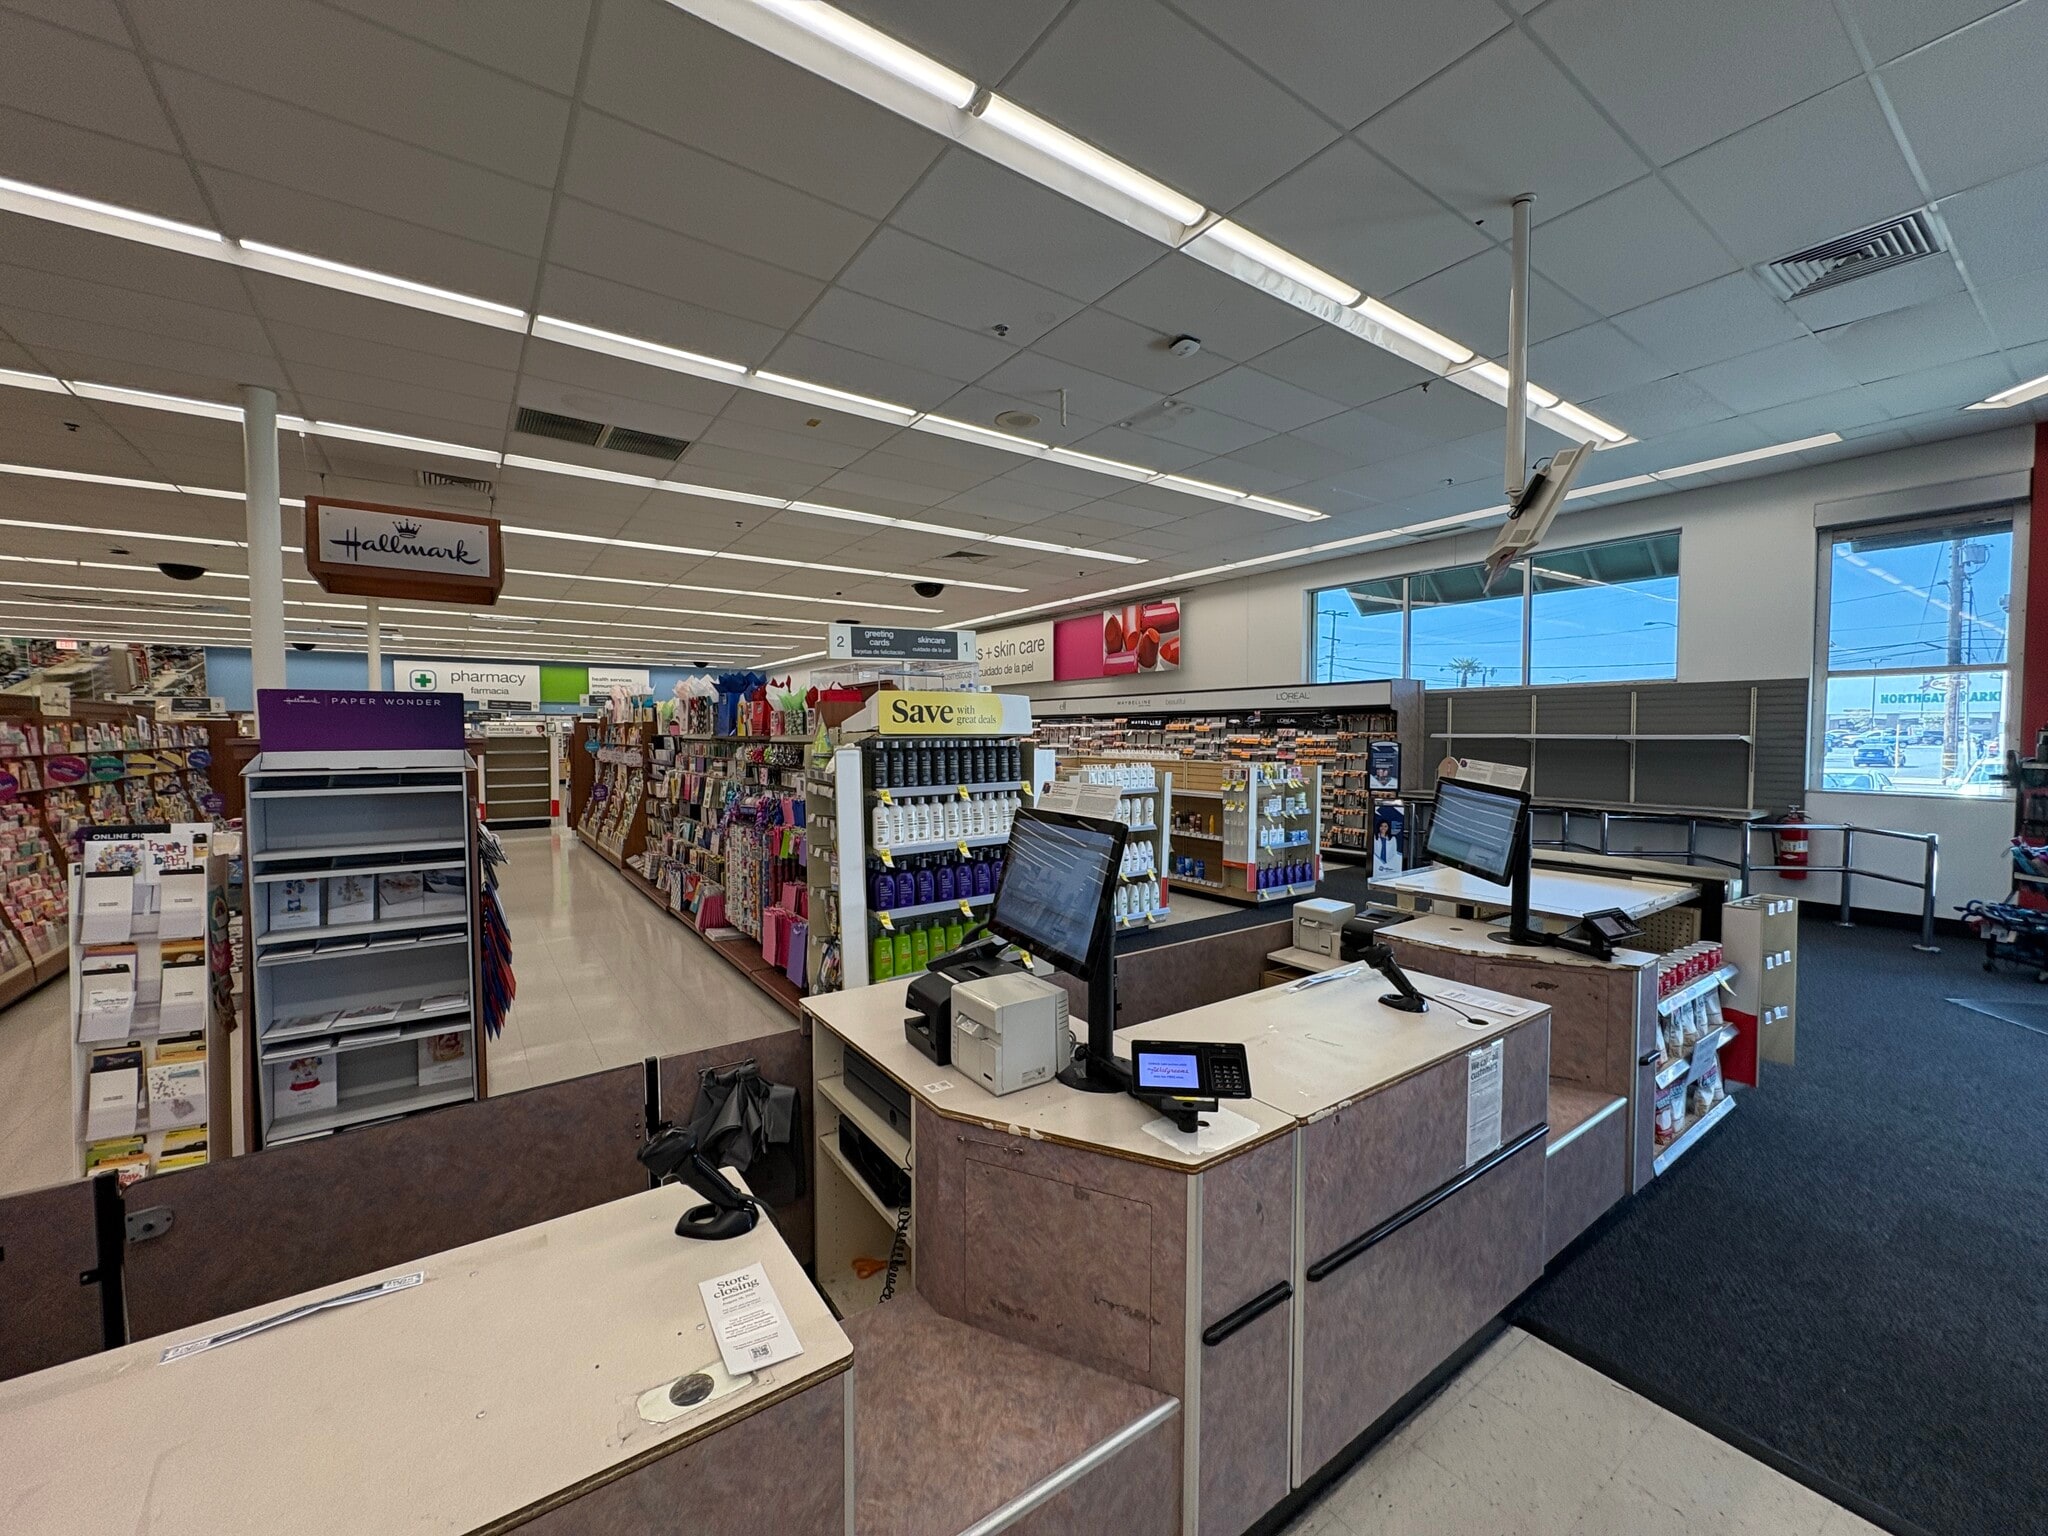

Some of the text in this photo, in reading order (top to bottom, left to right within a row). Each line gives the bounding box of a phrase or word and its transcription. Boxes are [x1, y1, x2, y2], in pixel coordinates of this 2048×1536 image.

[329, 526, 481, 565] Hallmark
[864, 630, 895, 640] greeting
[917, 636, 946, 645] skincare
[836, 635, 845, 648] 2
[868, 638, 891, 647] cards
[963, 641, 969, 652] 1
[994, 639, 1016, 659] skin
[1018, 637, 1046, 655] care
[977, 664, 1003, 678] cuidado
[1004, 663, 1013, 675] de
[1013, 662, 1020, 674] la
[1020, 660, 1034, 674] piel
[450, 670, 526, 686] pharmacy
[470, 686, 510, 696] farmacia
[331, 697, 377, 705] PAPER
[383, 698, 442, 706] WONDER
[1880, 692, 1946, 704] NORTHGAT
[891, 698, 976, 724] Save with
[956, 714, 997, 725] great deals
[92, 832, 145, 841] ONLINE PIC
[147, 839, 187, 856] happy
[716, 1274, 750, 1289] Store
[713, 1279, 760, 1299] closing
